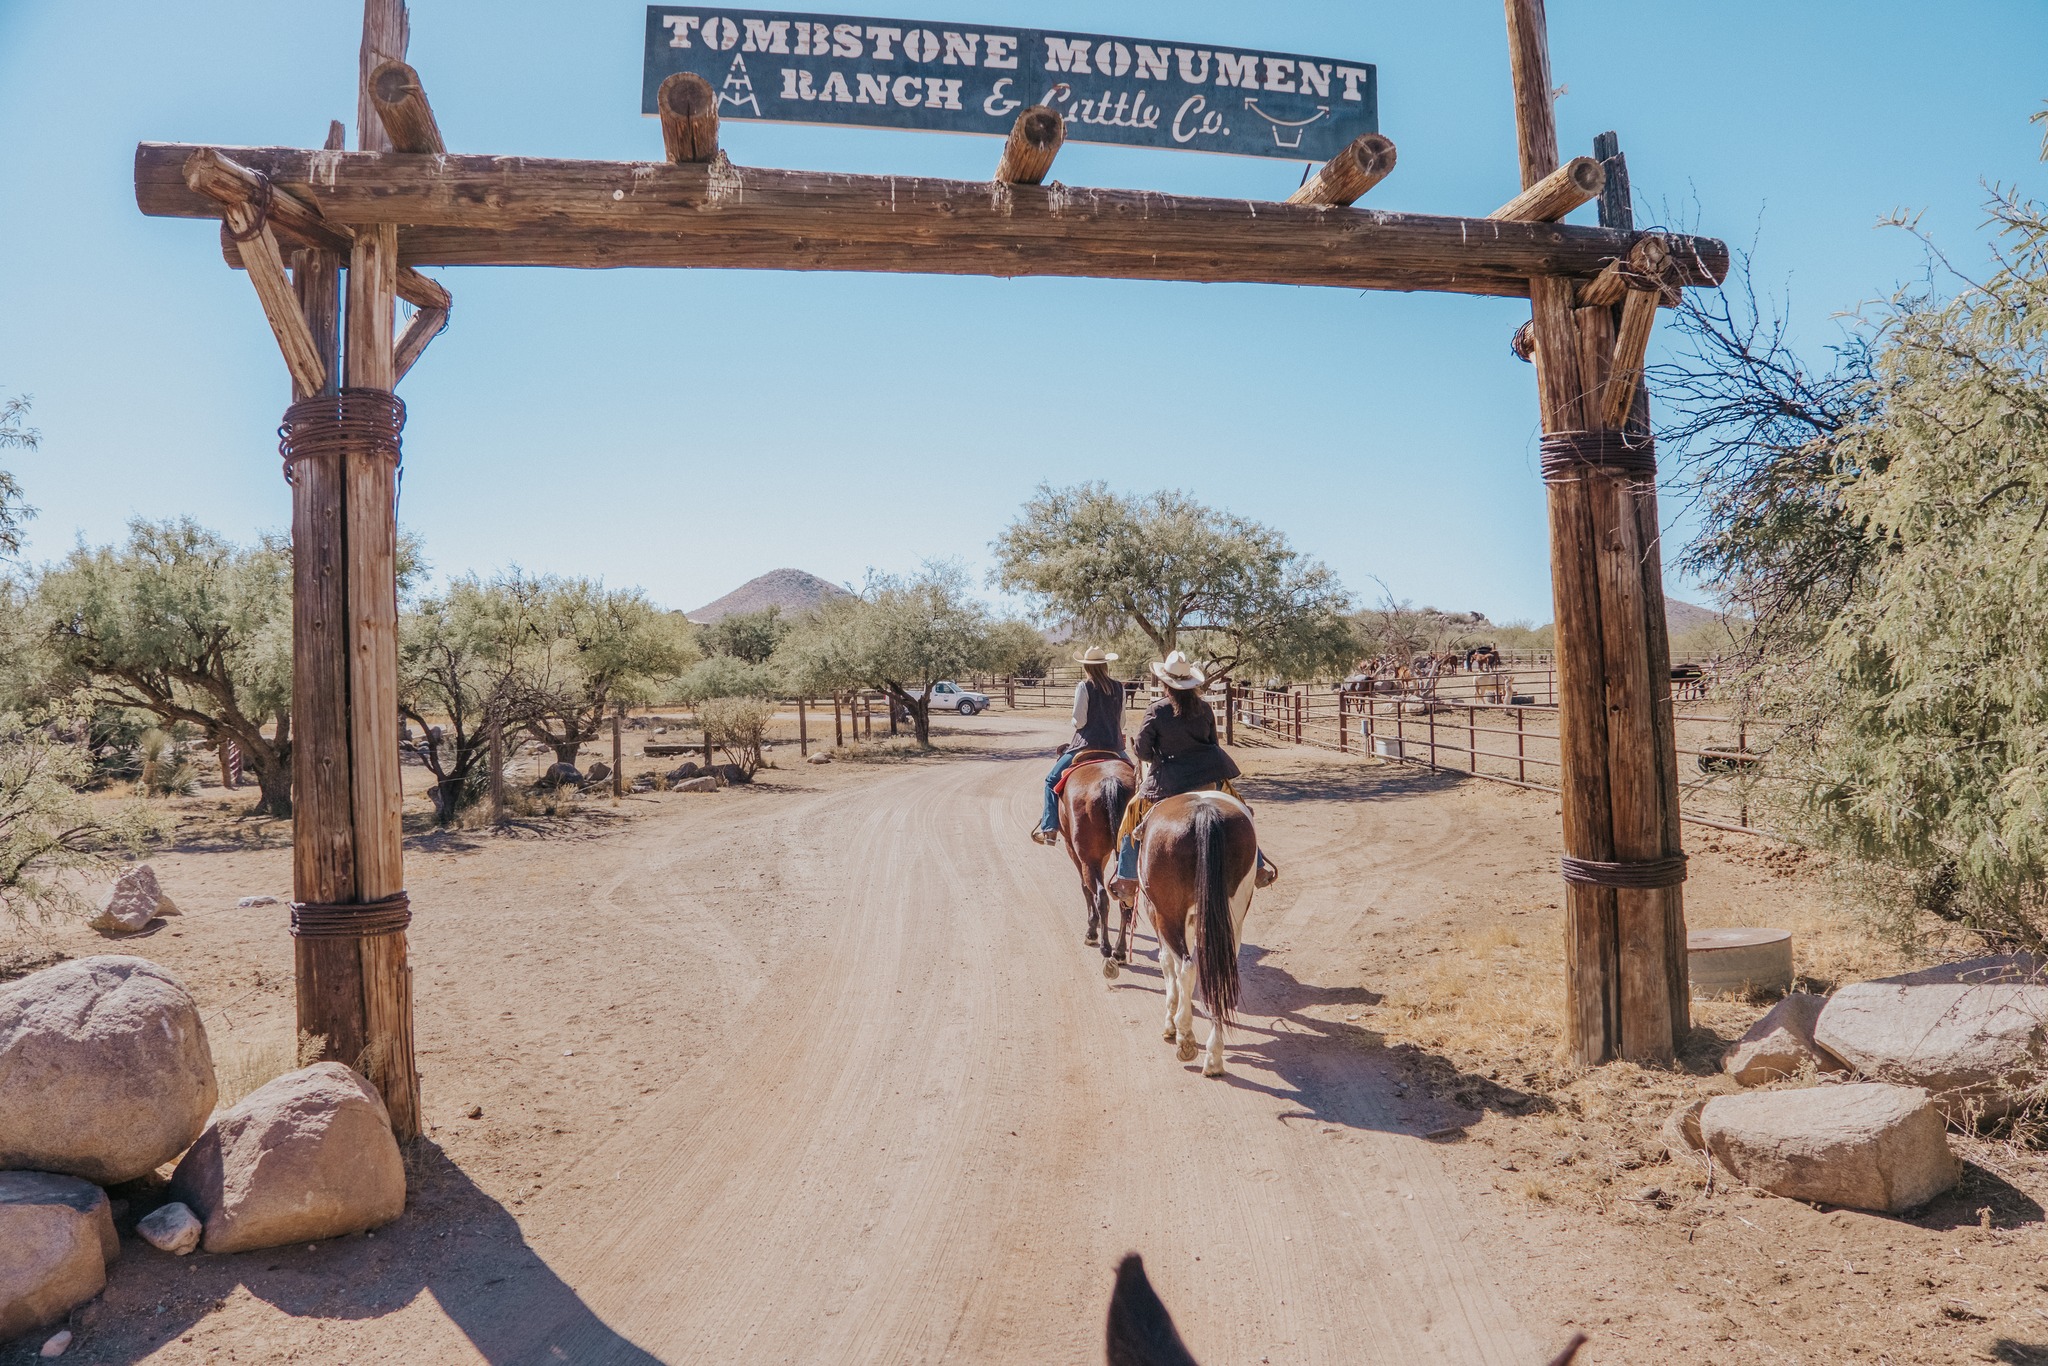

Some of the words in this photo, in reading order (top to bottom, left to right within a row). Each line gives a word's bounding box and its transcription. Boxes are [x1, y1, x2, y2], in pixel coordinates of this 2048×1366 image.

[663, 15, 1018, 69] TOMBSTONE
[1044, 37, 1366, 101] MONUMENT
[780, 69, 963, 110] RANCH
[984, 78, 1021, 117] &
[1172, 94, 1230, 143] Co.
